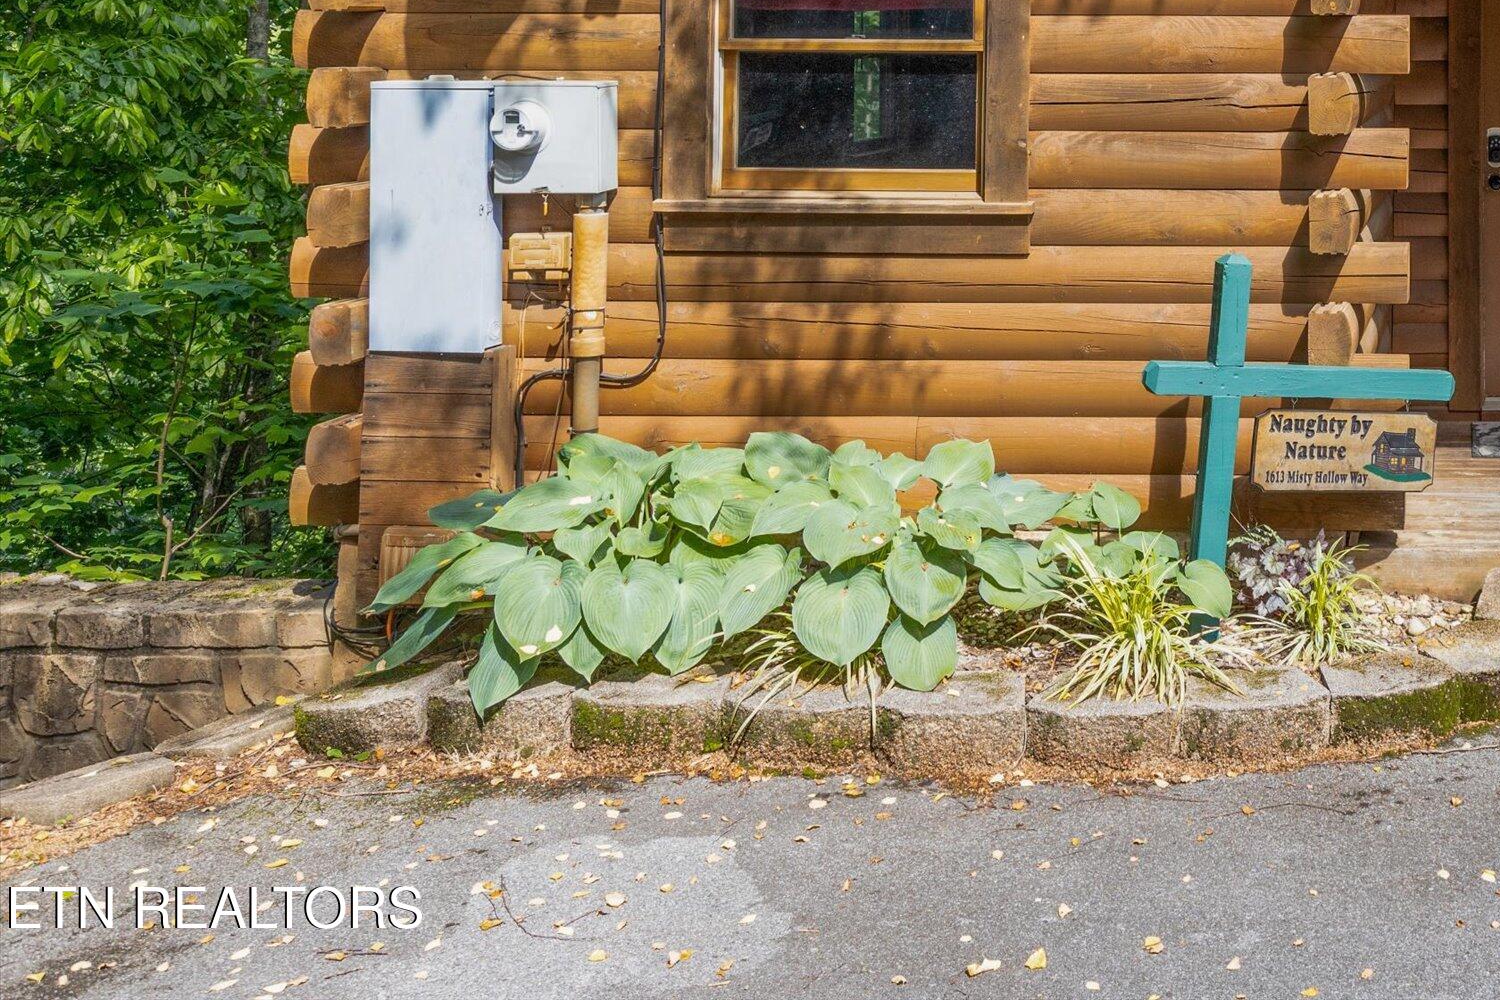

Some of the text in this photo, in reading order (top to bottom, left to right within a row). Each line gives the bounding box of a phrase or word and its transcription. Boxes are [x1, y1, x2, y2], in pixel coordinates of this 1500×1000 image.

[1270, 414, 1373, 439] Naughty by
[1285, 441, 1347, 460] Nature
[1266, 470, 1368, 486] 1613 Misty Hollow Way
